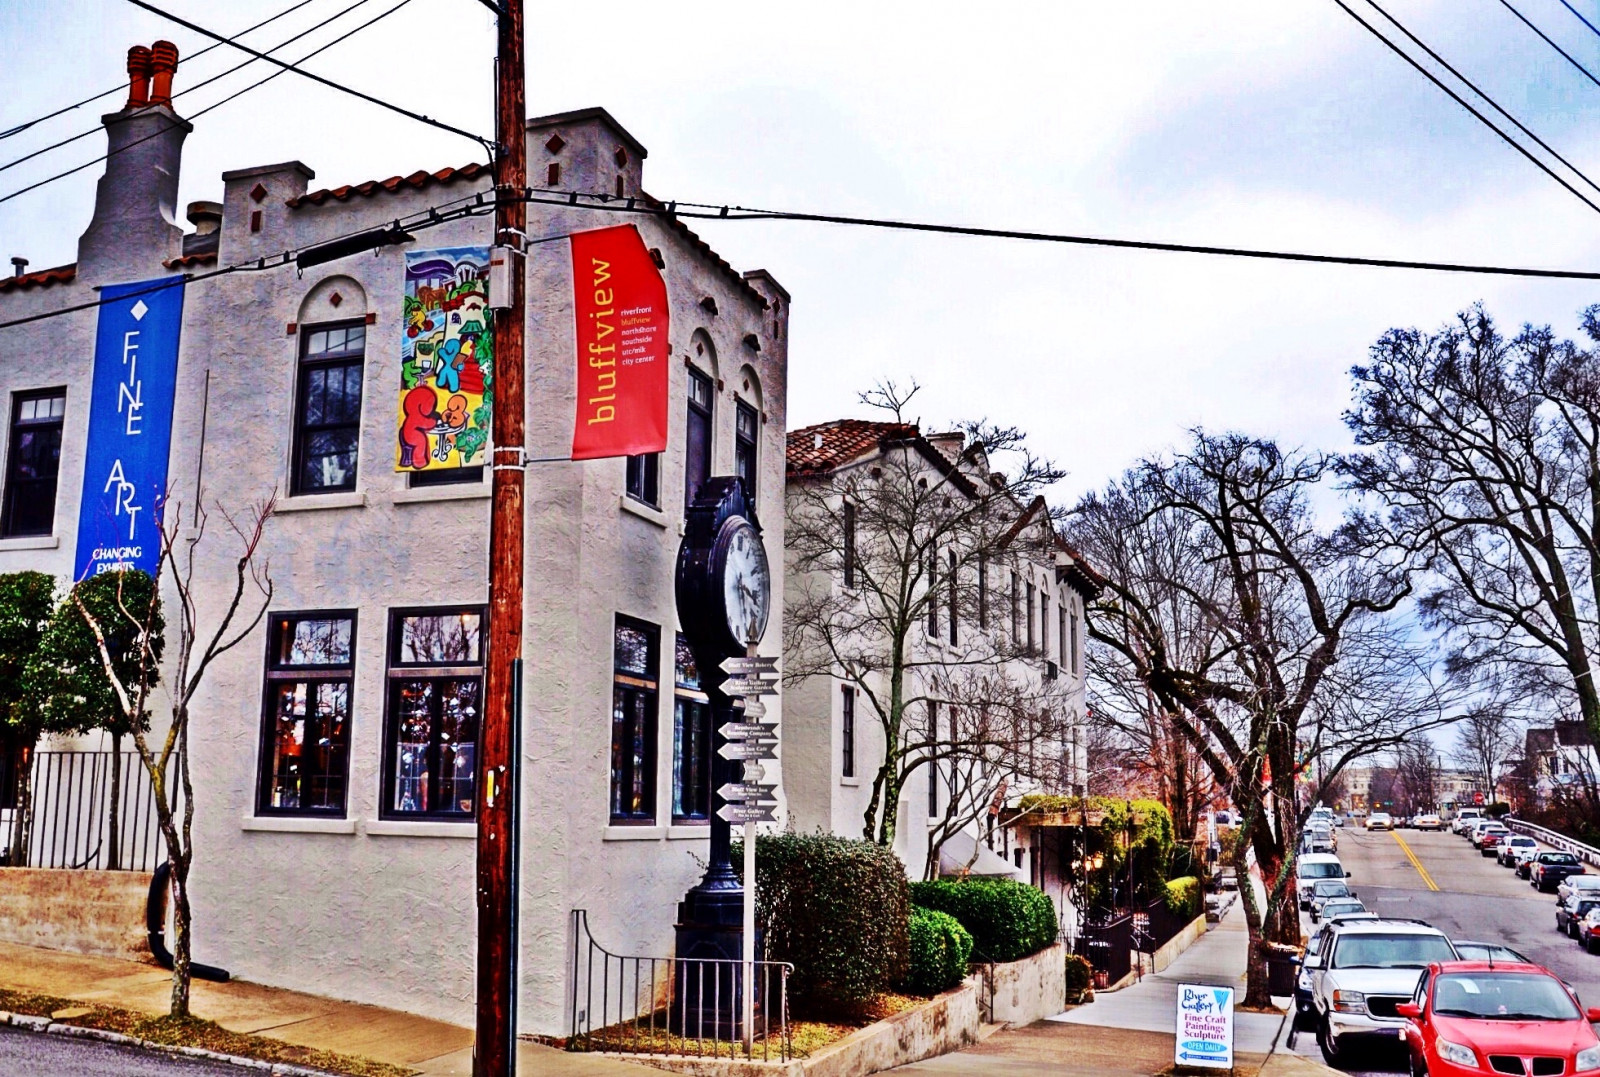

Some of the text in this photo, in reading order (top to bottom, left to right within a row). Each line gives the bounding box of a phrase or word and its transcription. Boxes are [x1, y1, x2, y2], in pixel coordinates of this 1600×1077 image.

[620, 306, 652, 316] riverfront
[621, 317, 651, 326] bluffview
[588, 257, 616, 425] bluffview
[621, 336, 652, 346] southside
[621, 355, 655, 366] city center
[117, 331, 144, 436] FINE
[104, 459, 142, 541] ART
[92, 546, 142, 560] CHANGING
[1184, 989, 1208, 1001] River
[1181, 1000, 1214, 1013] Gallery
[1184, 1013, 1226, 1024] Fine Craft
[1185, 1022, 1225, 1034] Paintings
[1184, 1030, 1226, 1041] Sculpture
[1187, 1041, 1221, 1051] OPEN DAILY
